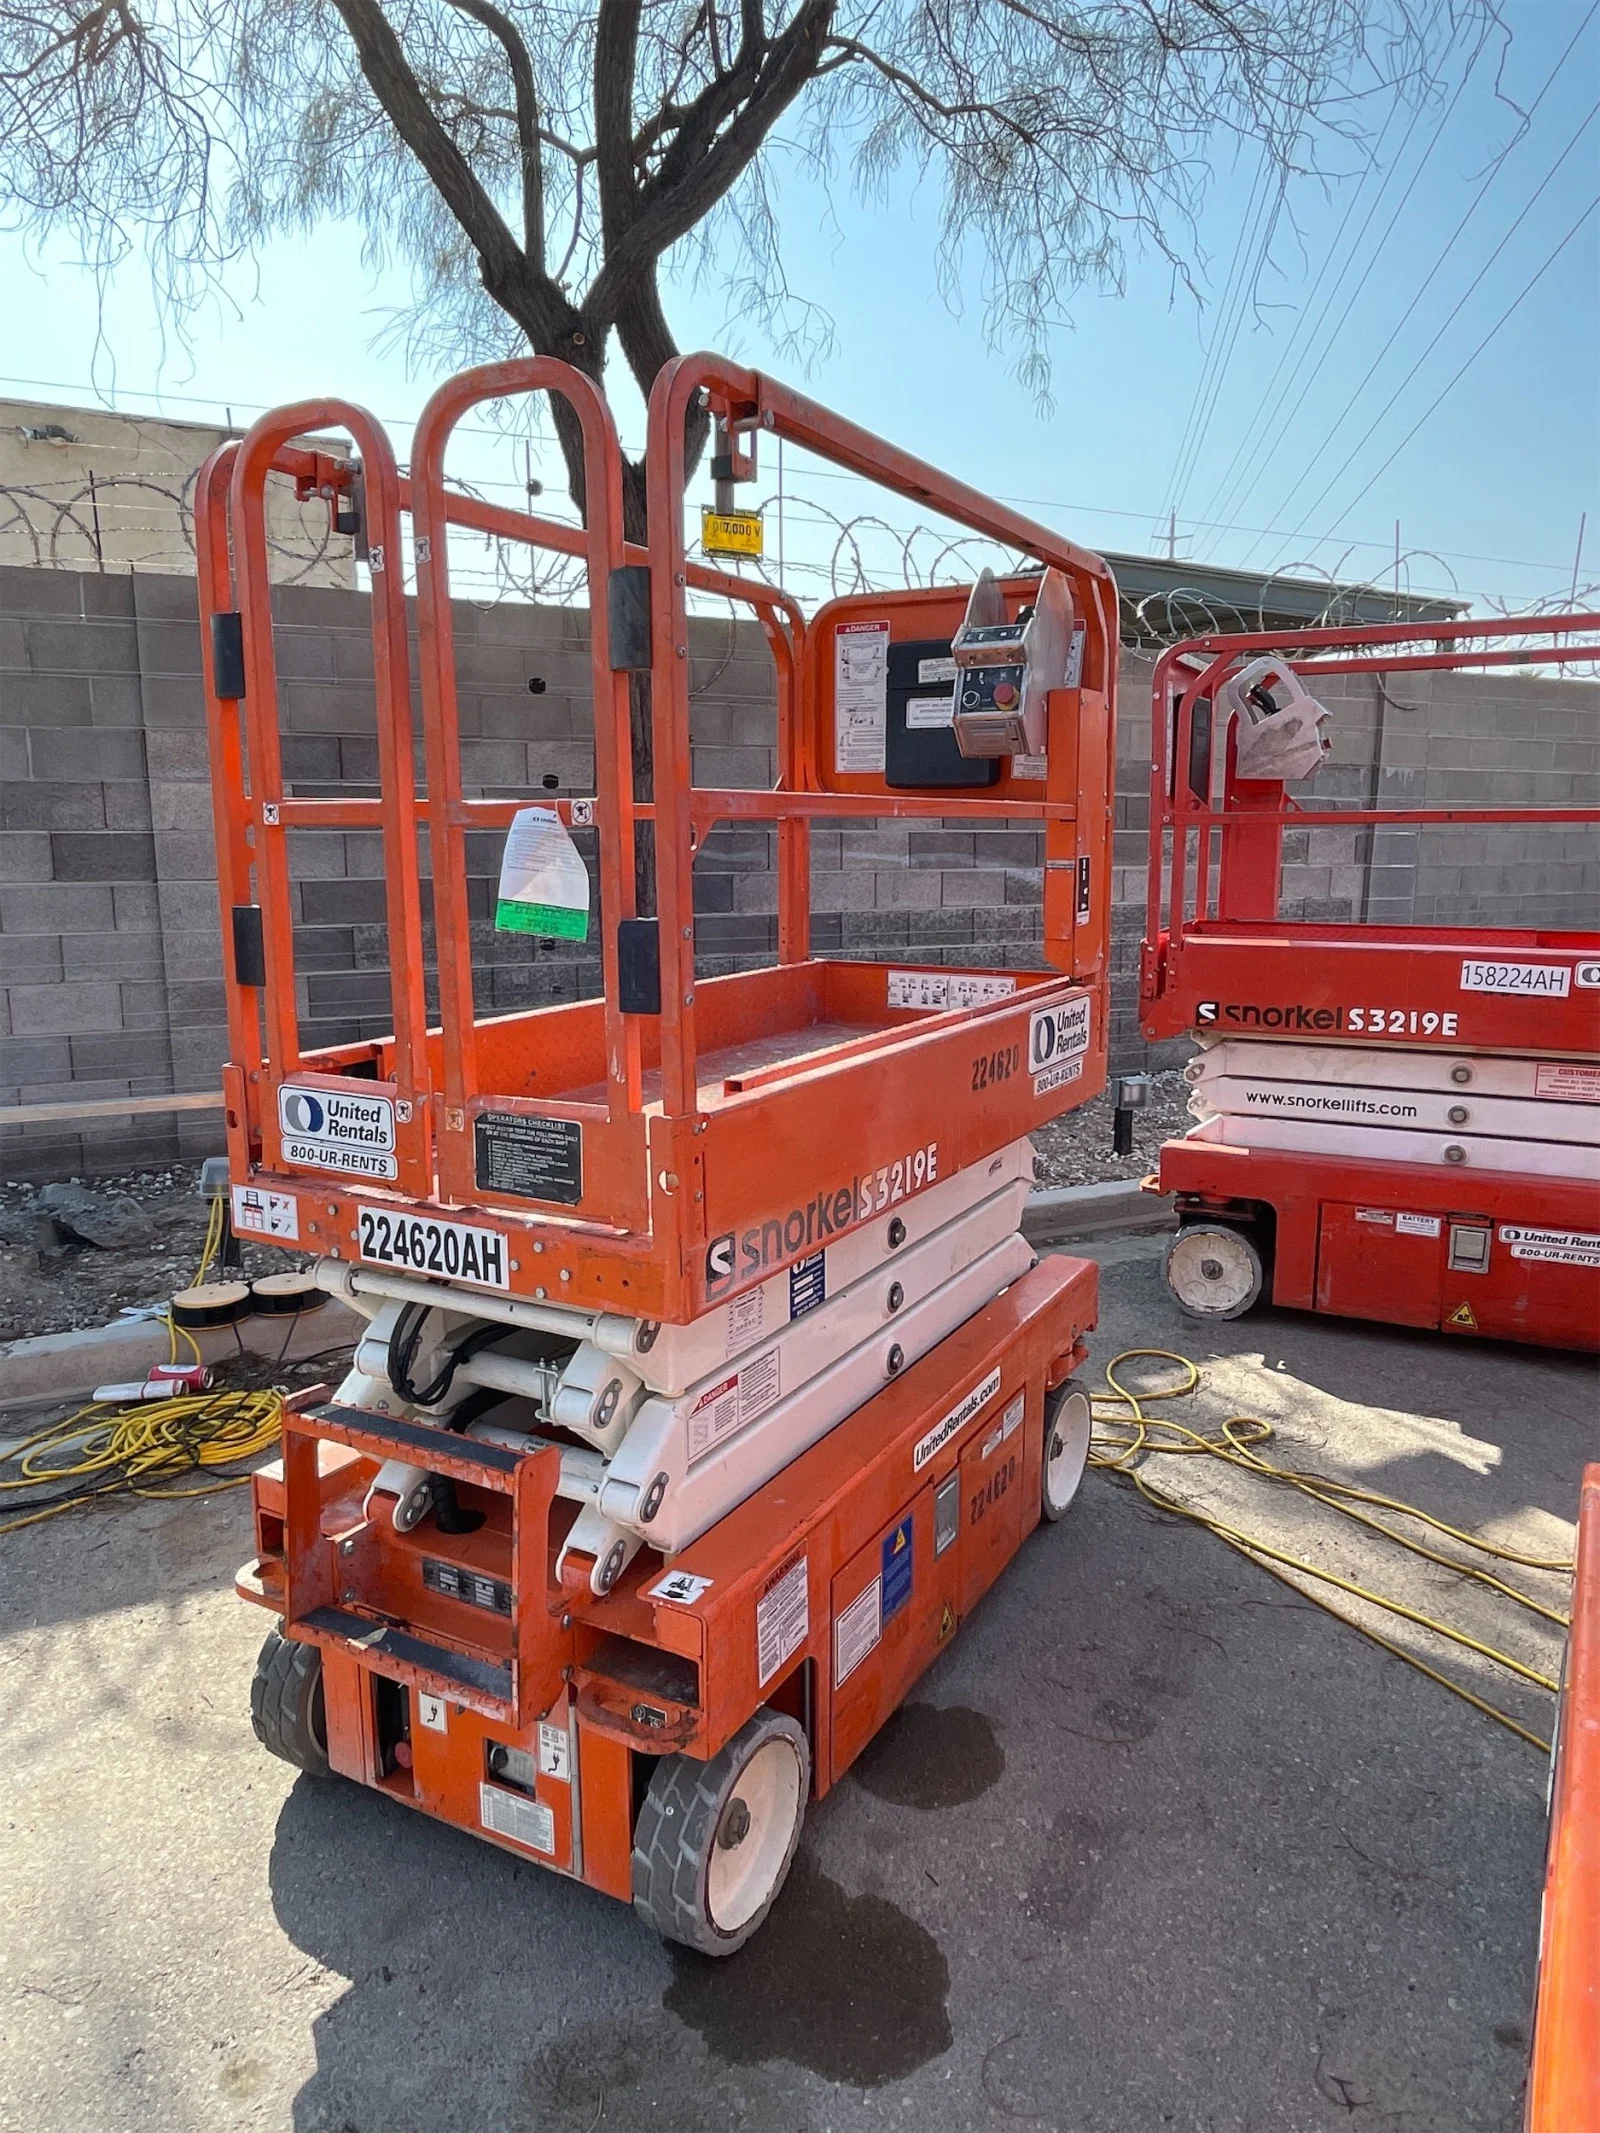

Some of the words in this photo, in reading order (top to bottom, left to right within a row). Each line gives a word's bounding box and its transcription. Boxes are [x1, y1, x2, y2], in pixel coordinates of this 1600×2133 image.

[850, 624, 880, 633] DANGER
[1463, 964, 1565, 991] 158224AH
[1057, 1003, 1087, 1033] United
[1224, 1004, 1343, 1031] snorkel
[1347, 1007, 1459, 1037] S3219E
[1056, 1026, 1087, 1056] Rentals
[972, 1044, 1020, 1091] 224620
[1037, 1062, 1081, 1093] 800-UR-RENTS
[327, 1099, 381, 1123] United
[1246, 1091, 1418, 1118] www.snorkellifts.com
[328, 1119, 388, 1144] Rentals
[528, 1119, 566, 1129] CHECKLIST
[290, 1145, 388, 1173] 800-UR-RENTS
[741, 1175, 859, 1278] snorkel
[858, 1141, 938, 1221] S3219E
[1402, 1214, 1436, 1225] BATTERY
[360, 1212, 502, 1285] 224620AH
[1524, 1231, 1569, 1245] United
[1519, 1248, 1600, 1264] 800-UR-RENTS
[703, 1382, 729, 1404] DANGER
[915, 1375, 1000, 1466] UnitedRentals.com
[970, 1455, 1016, 1525] 224620
[766, 1551, 801, 1590] WARNING
